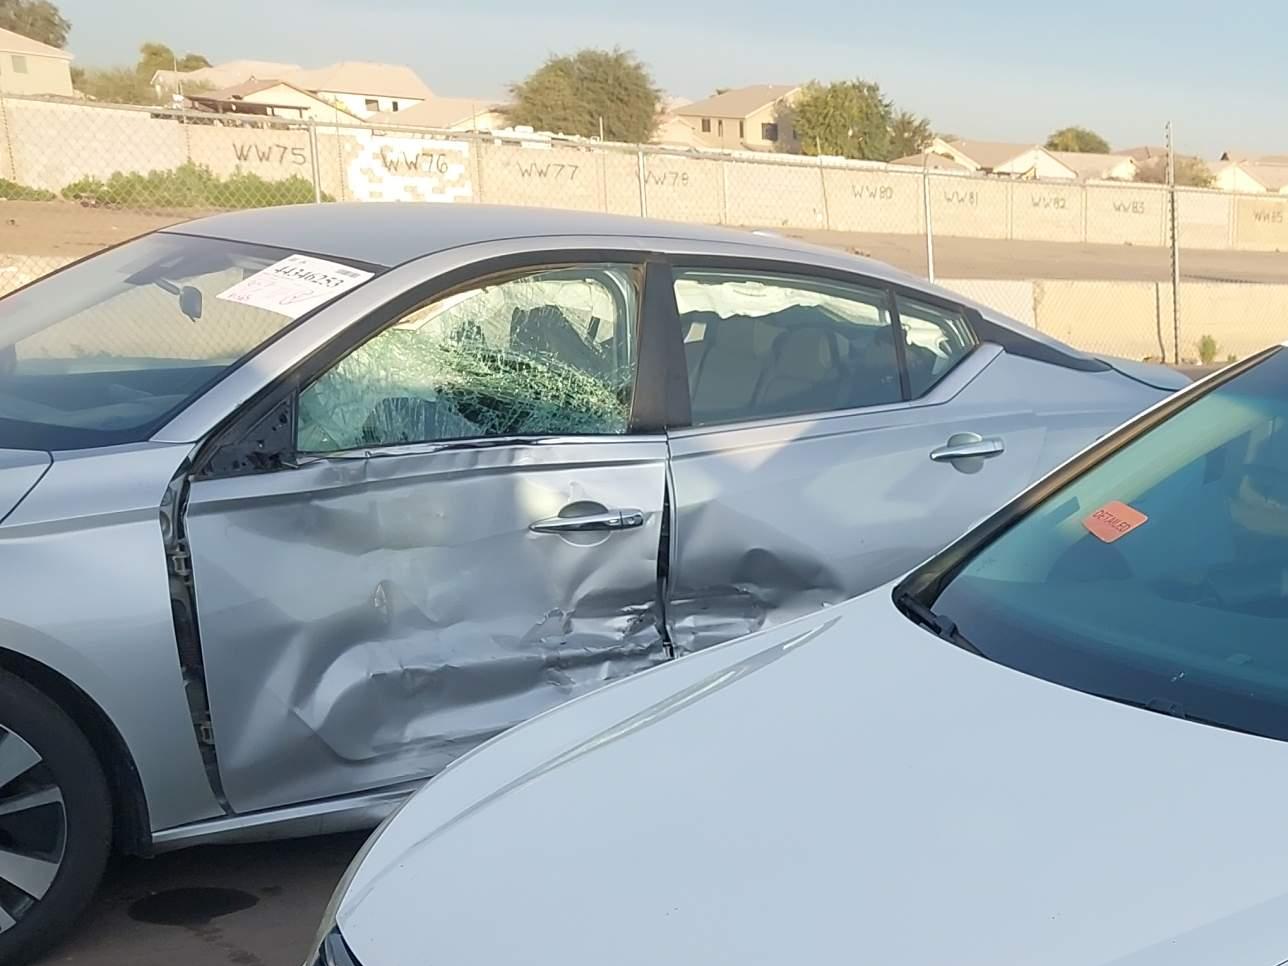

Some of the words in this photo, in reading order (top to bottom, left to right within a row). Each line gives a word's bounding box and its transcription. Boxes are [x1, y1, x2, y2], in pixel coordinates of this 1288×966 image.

[232, 143, 307, 166] WW75
[380, 146, 449, 174] WW76
[516, 161, 579, 180] WW77
[851, 184, 894, 200] WW80
